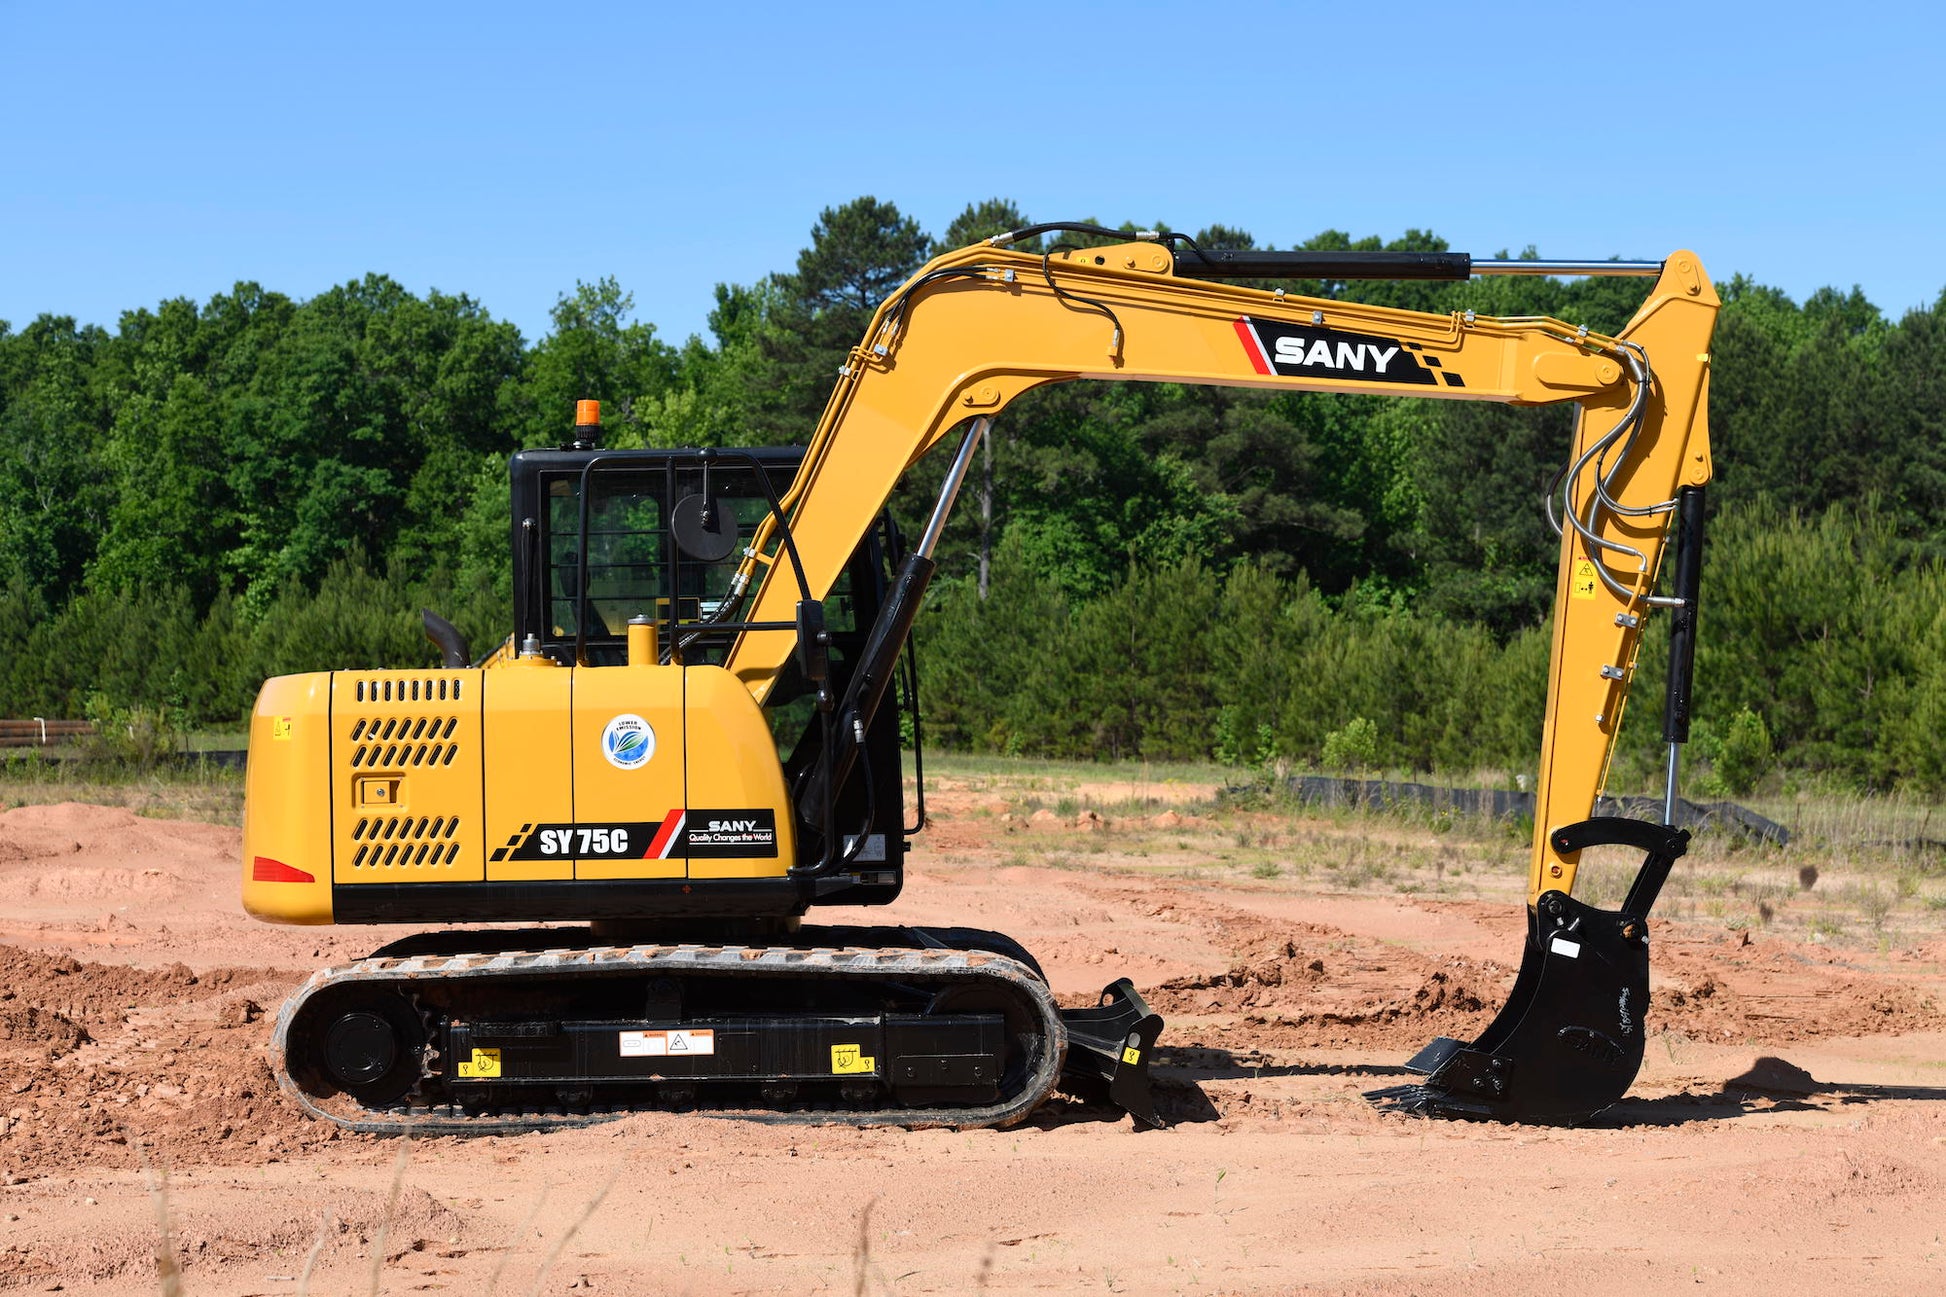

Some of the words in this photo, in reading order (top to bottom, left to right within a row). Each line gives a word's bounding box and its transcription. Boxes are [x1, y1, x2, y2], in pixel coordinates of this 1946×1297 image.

[1275, 336, 1400, 374] SANY
[708, 820, 757, 832] SANY
[540, 829, 573, 855] SY
[576, 828, 629, 855] 75C
[689, 833, 712, 843] Quality
[713, 833, 741, 843] Changes
[741, 833, 754, 841] the
[753, 833, 772, 841] World
